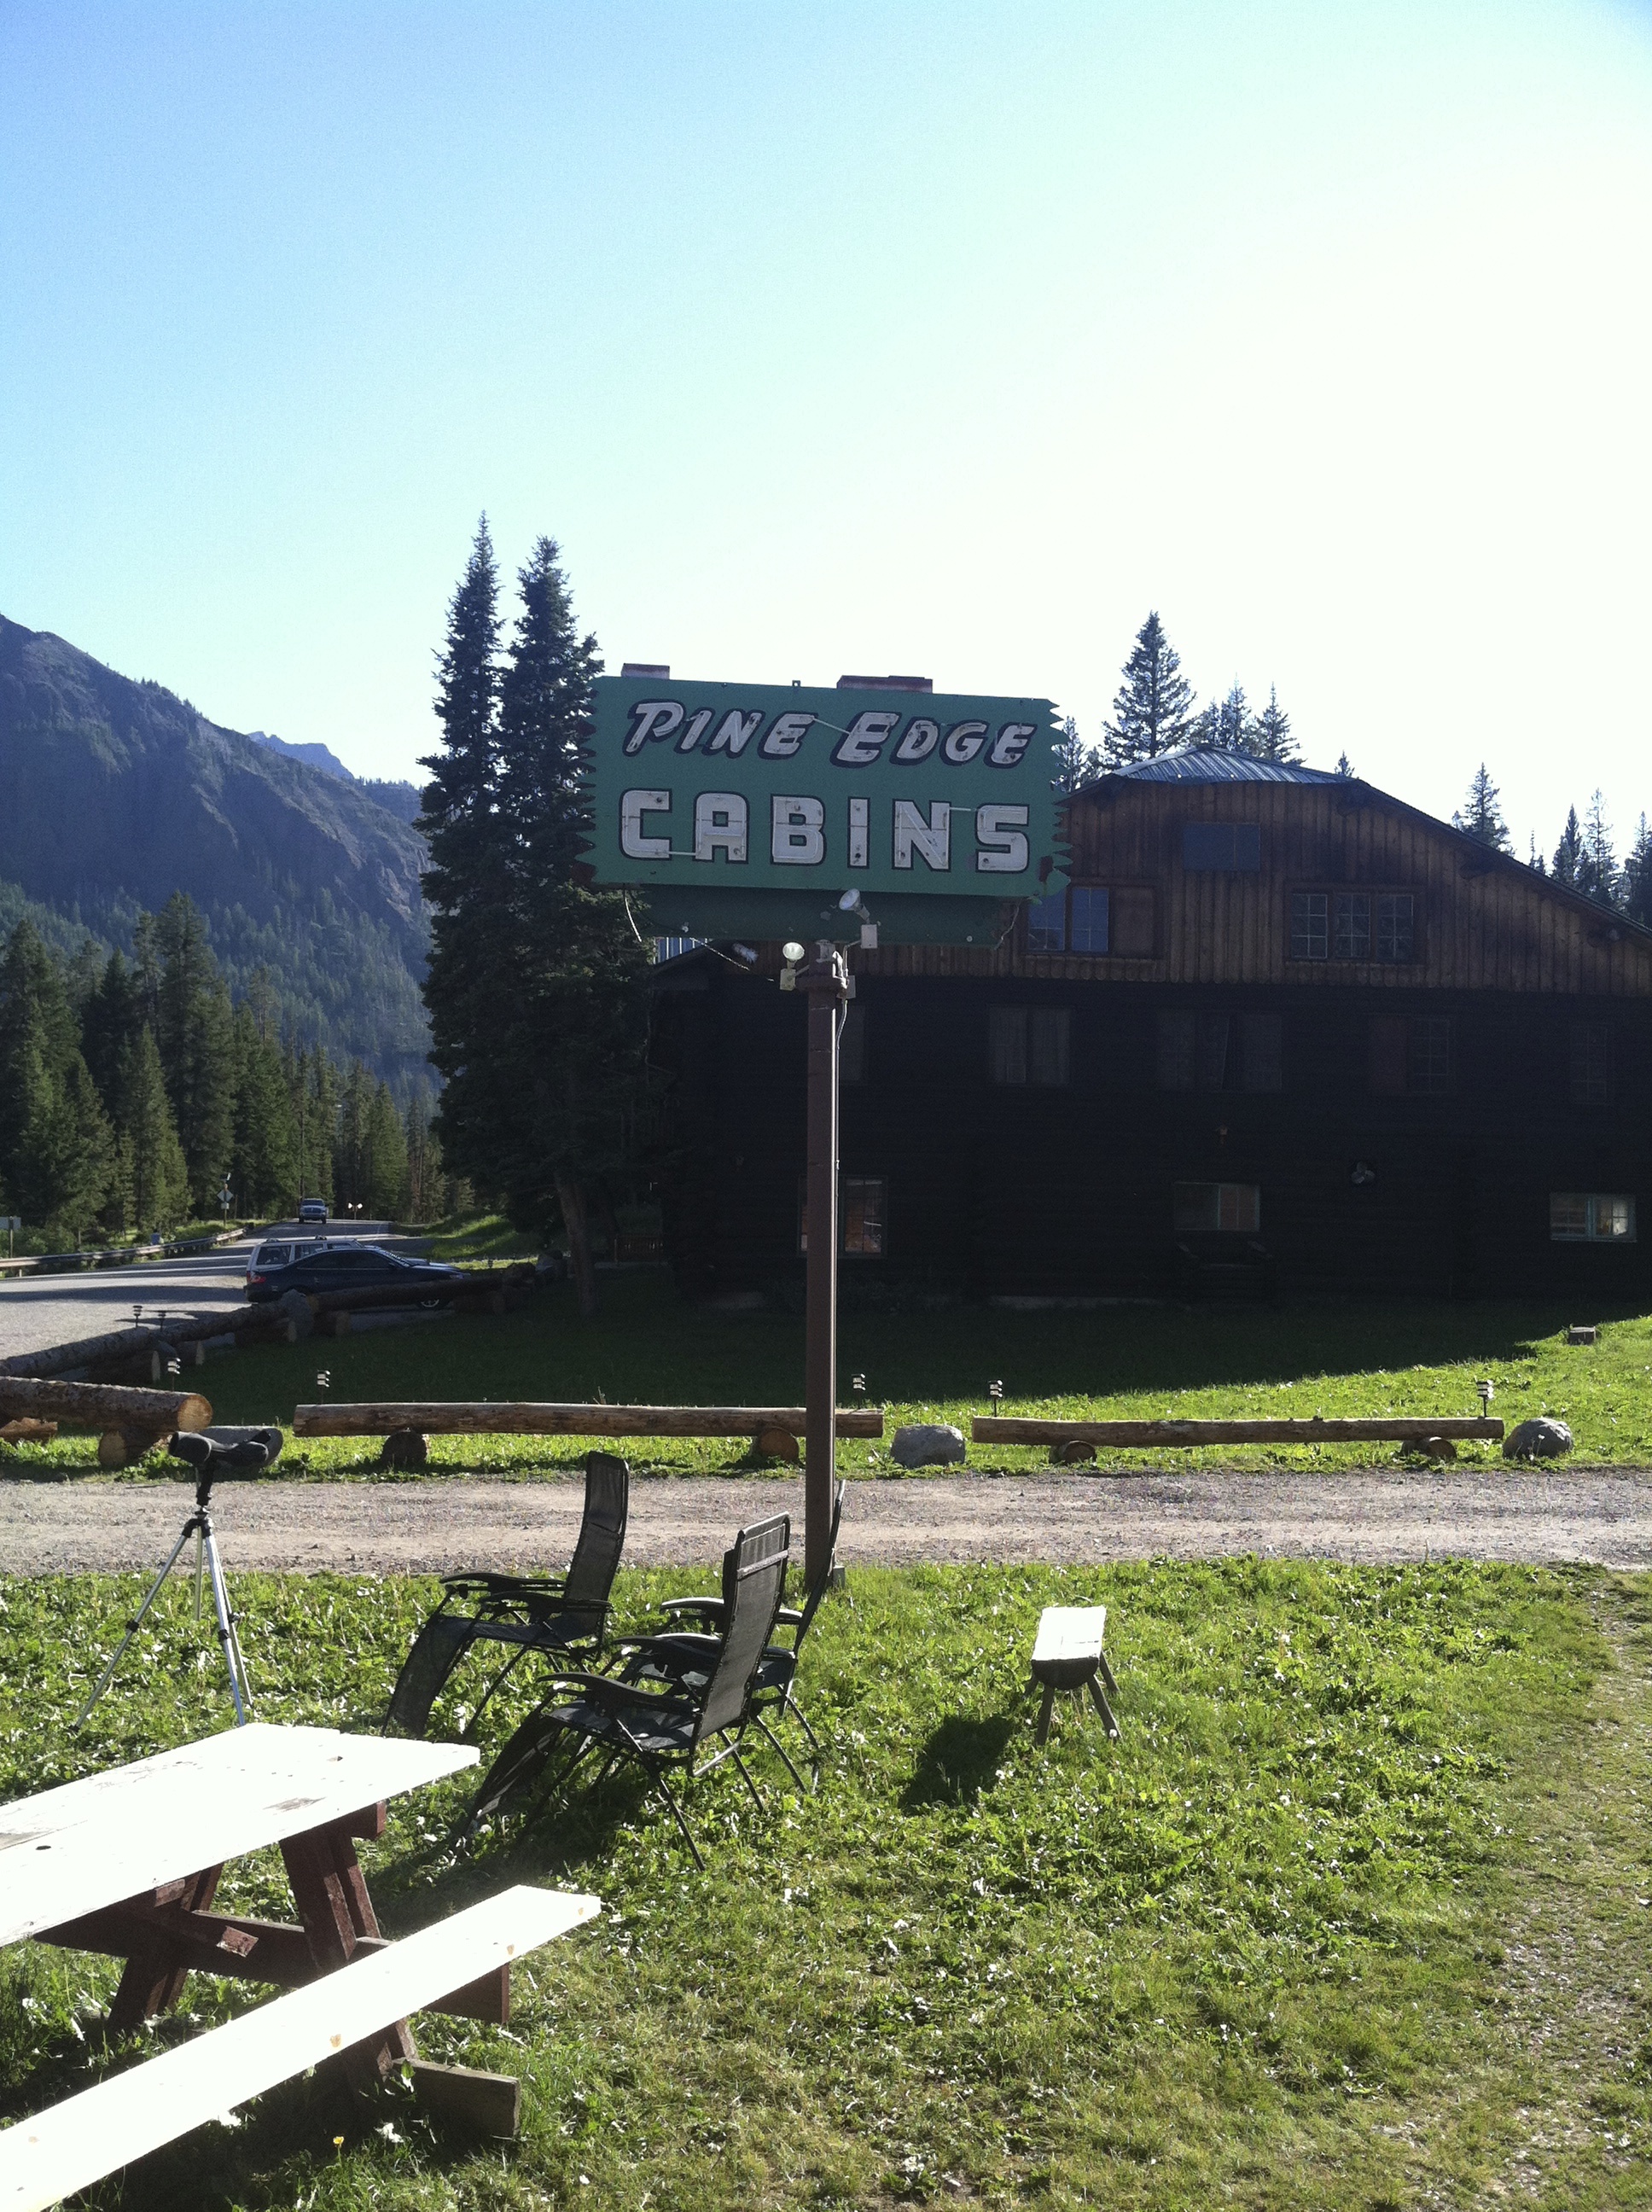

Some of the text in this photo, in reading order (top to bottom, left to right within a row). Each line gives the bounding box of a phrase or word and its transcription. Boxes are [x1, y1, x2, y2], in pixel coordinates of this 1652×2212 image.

[623, 700, 1035, 765] PINE EDGE
[620, 789, 1030, 872] CABINS
